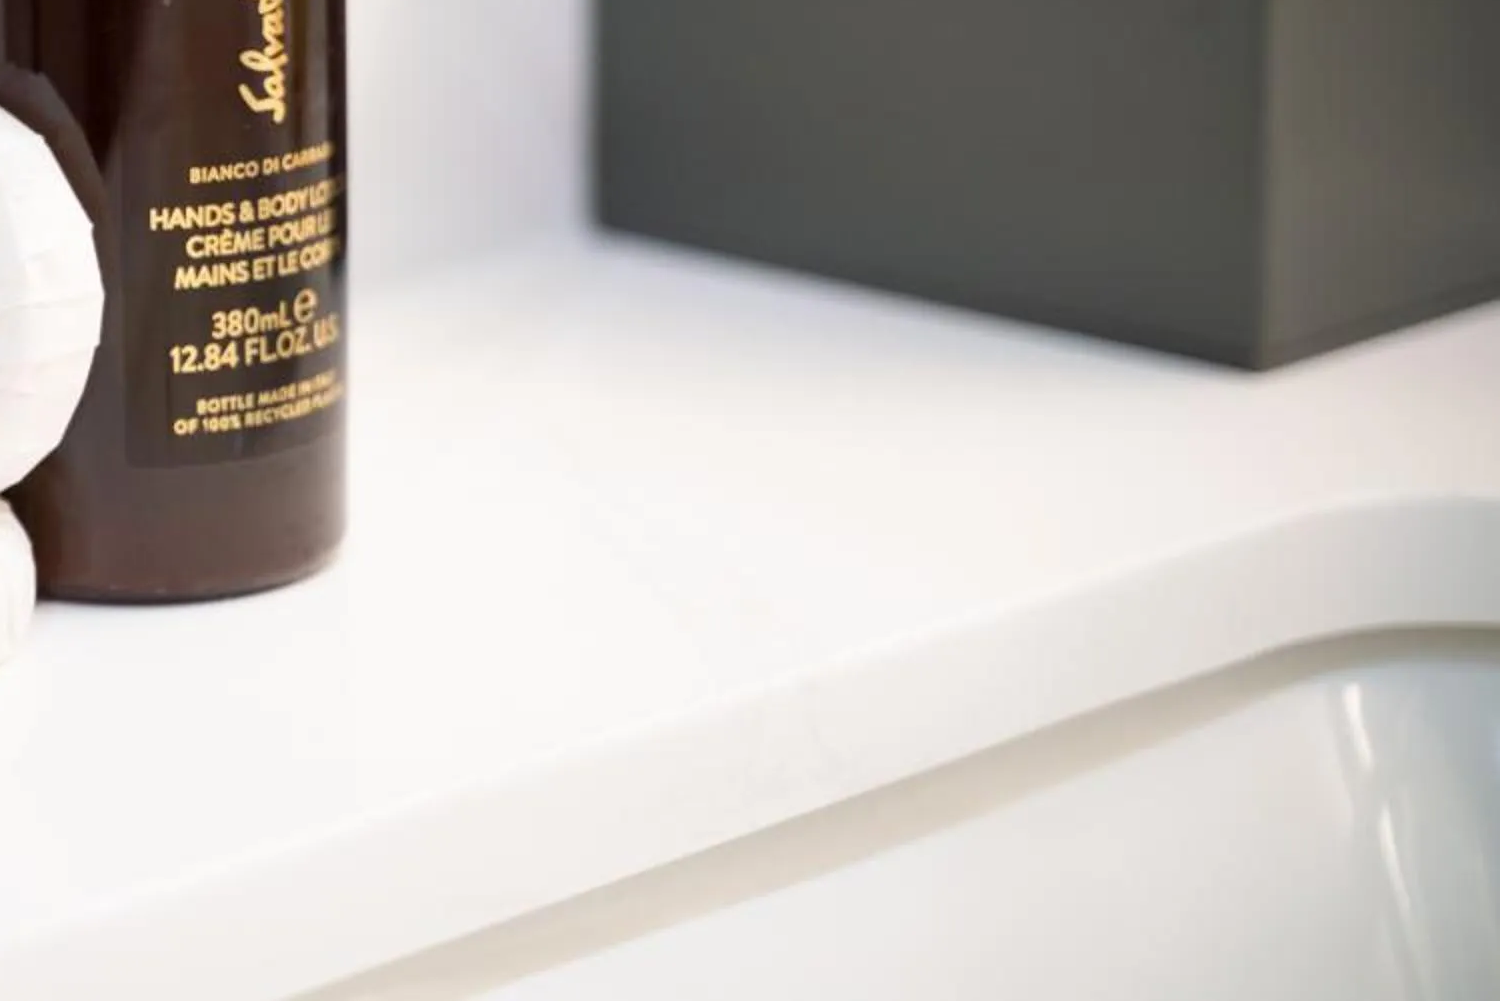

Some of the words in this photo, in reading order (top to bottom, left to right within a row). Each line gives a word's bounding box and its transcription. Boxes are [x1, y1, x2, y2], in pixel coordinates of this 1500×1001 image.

[189, 160, 259, 184] BIANCO
[263, 155, 280, 176] DI
[149, 201, 235, 231] HANDS
[239, 199, 255, 224] &
[257, 184, 309, 219] BODY
[186, 227, 266, 259] CRÈME
[267, 213, 317, 249] POUR
[173, 259, 251, 290] MAINS
[252, 254, 277, 282] ET
[277, 249, 300, 277] LE
[211, 300, 292, 340] 380mL
[169, 341, 240, 374] 12.84
[196, 392, 255, 416] BOTTLE
[258, 382, 297, 406] MADE
[173, 417, 199, 436] OF
[202, 413, 241, 433] 100%
